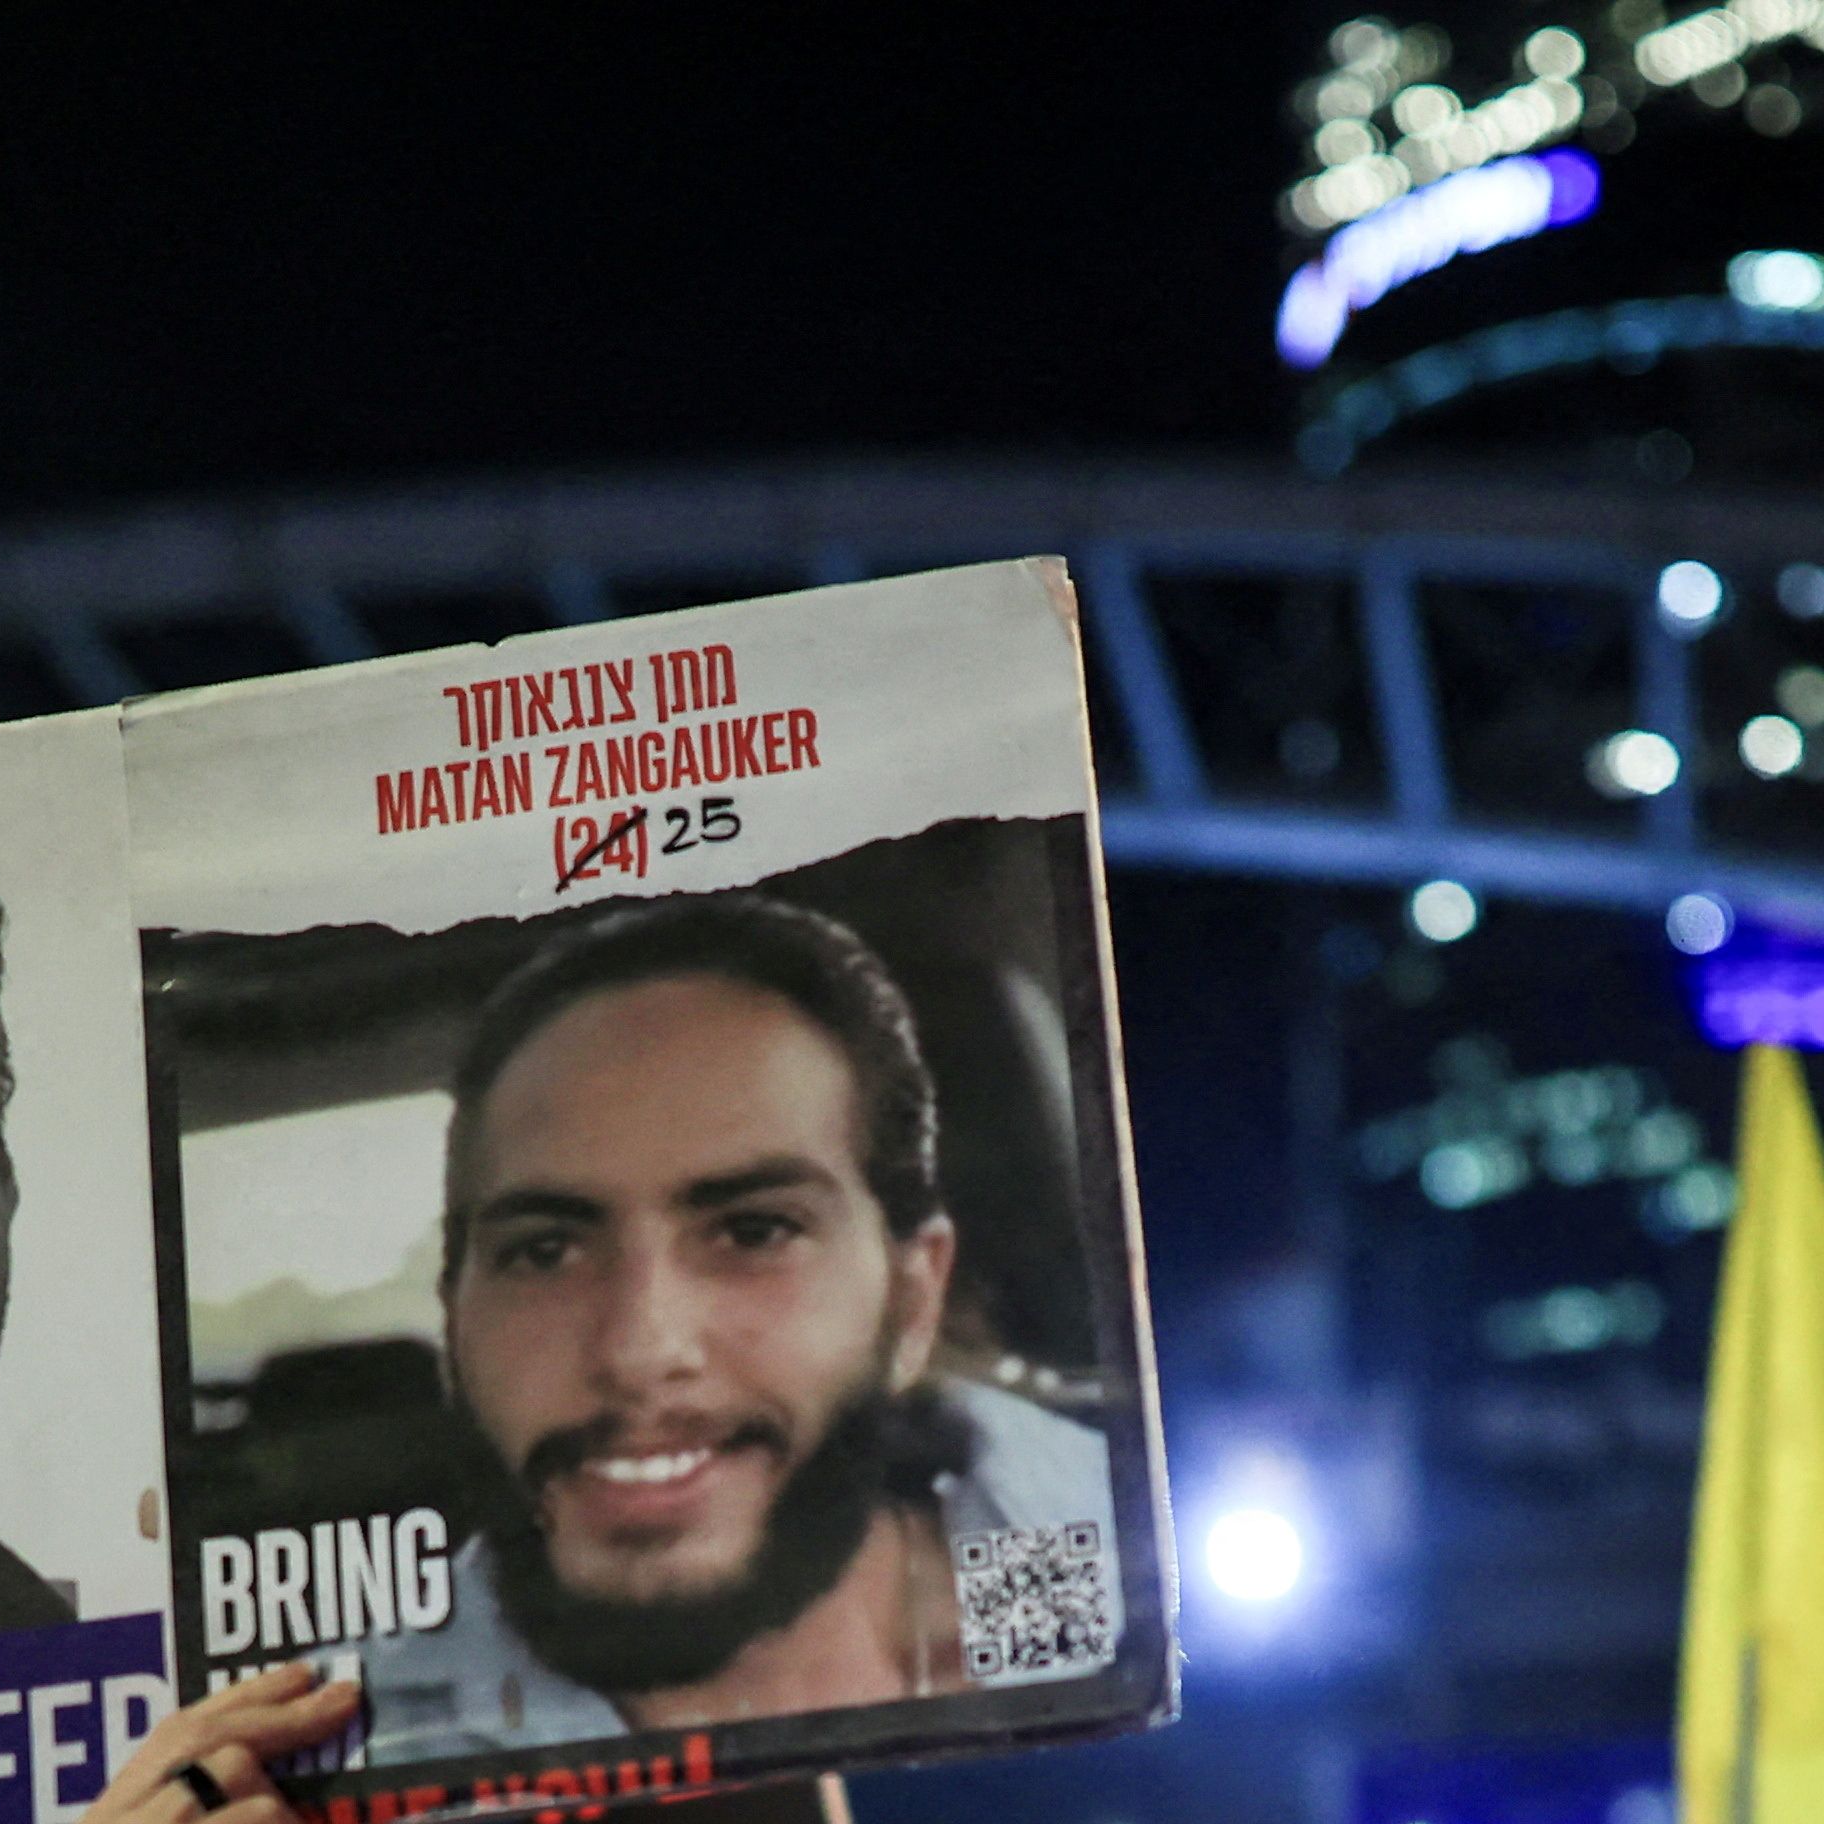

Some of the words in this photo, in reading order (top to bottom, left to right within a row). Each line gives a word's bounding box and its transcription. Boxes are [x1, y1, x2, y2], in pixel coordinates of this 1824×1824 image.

[443, 658, 637, 751] צנגאוקר
[650, 644, 737, 724] מתן
[376, 752, 534, 834] MATAN
[545, 708, 822, 808] ZANGAUKER
[661, 798, 742, 856] 25
[200, 1506, 453, 1657] BRING
